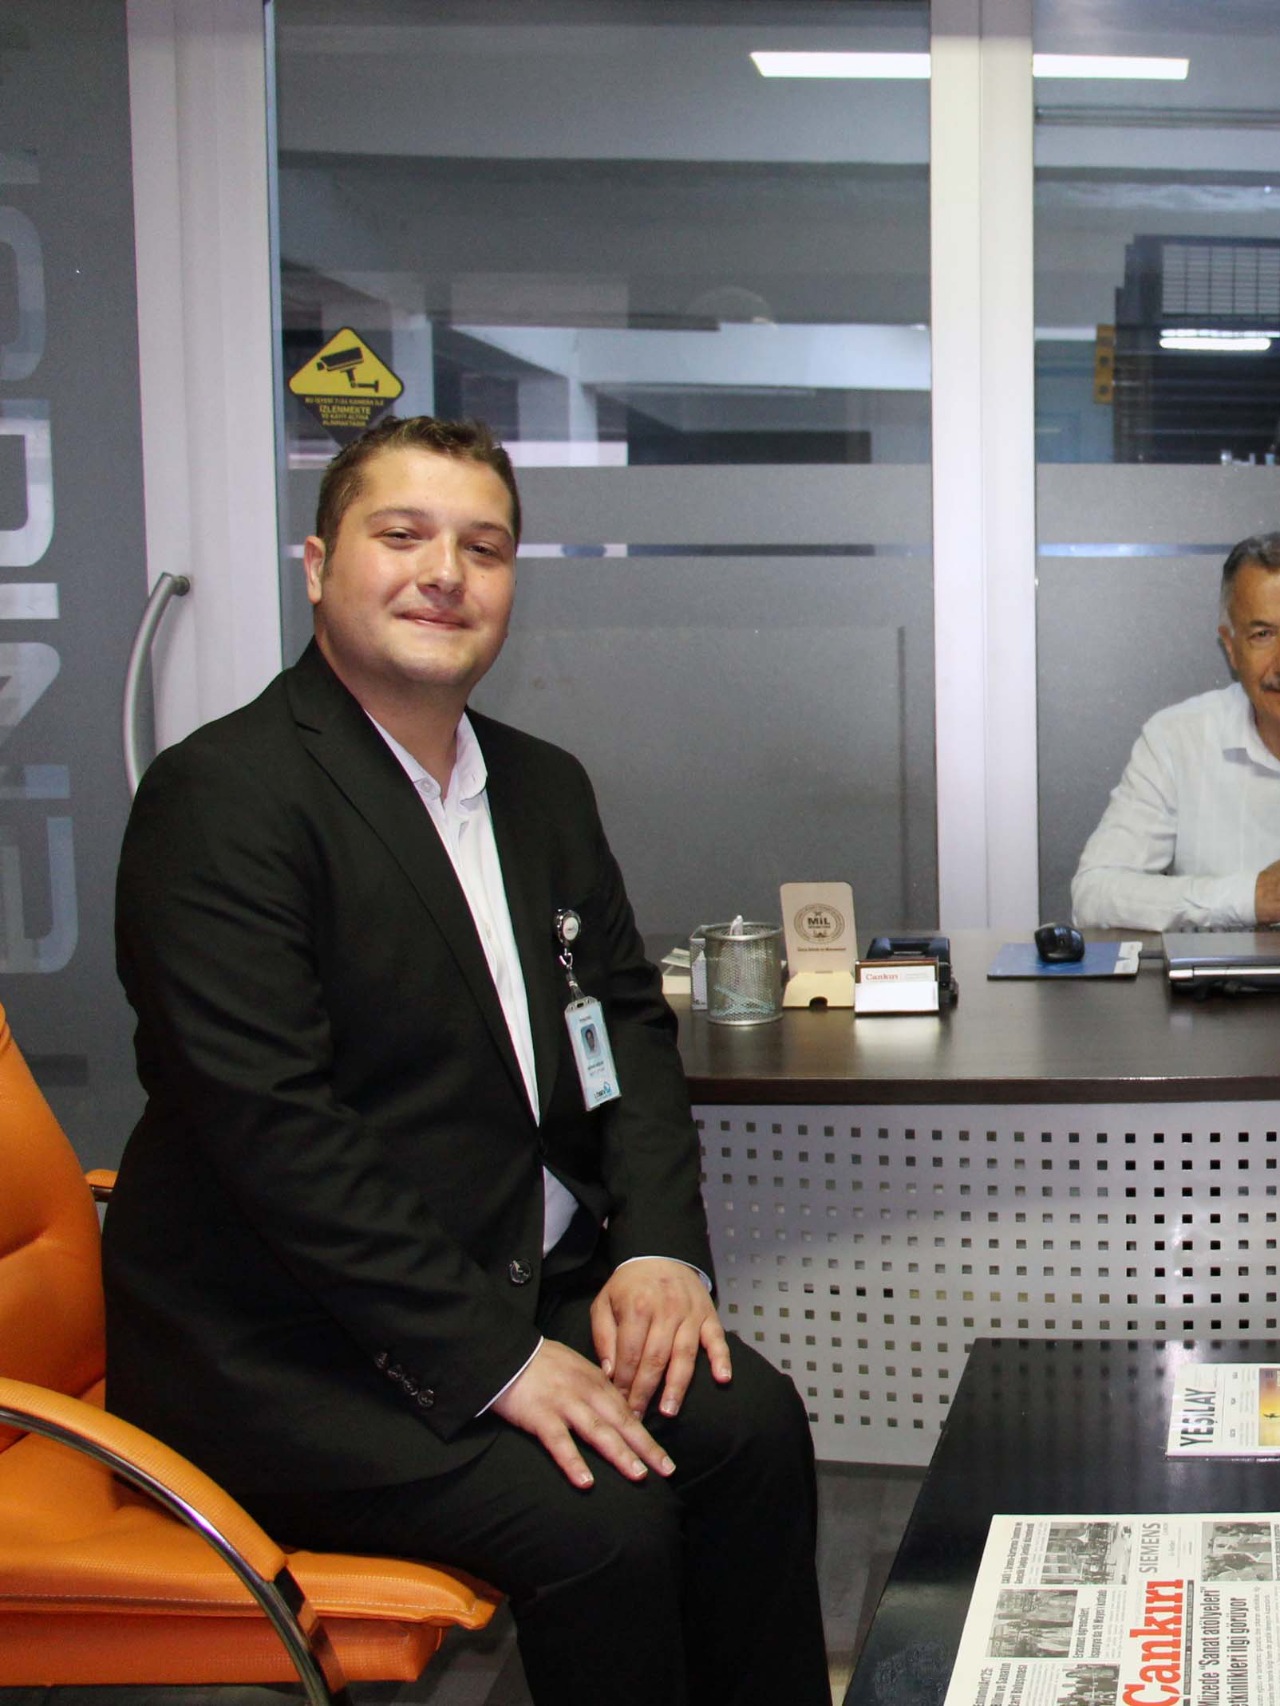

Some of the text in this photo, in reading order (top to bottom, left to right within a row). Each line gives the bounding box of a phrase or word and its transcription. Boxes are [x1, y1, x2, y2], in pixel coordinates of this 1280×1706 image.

[1139, 1522, 1162, 1574] SIEMENS
[1226, 1598, 1250, 1634] görüyor
[1122, 1580, 1184, 1706] Çankırı
[1226, 1636, 1250, 1652] ilgi
[1197, 1672, 1219, 1706] Müzede
